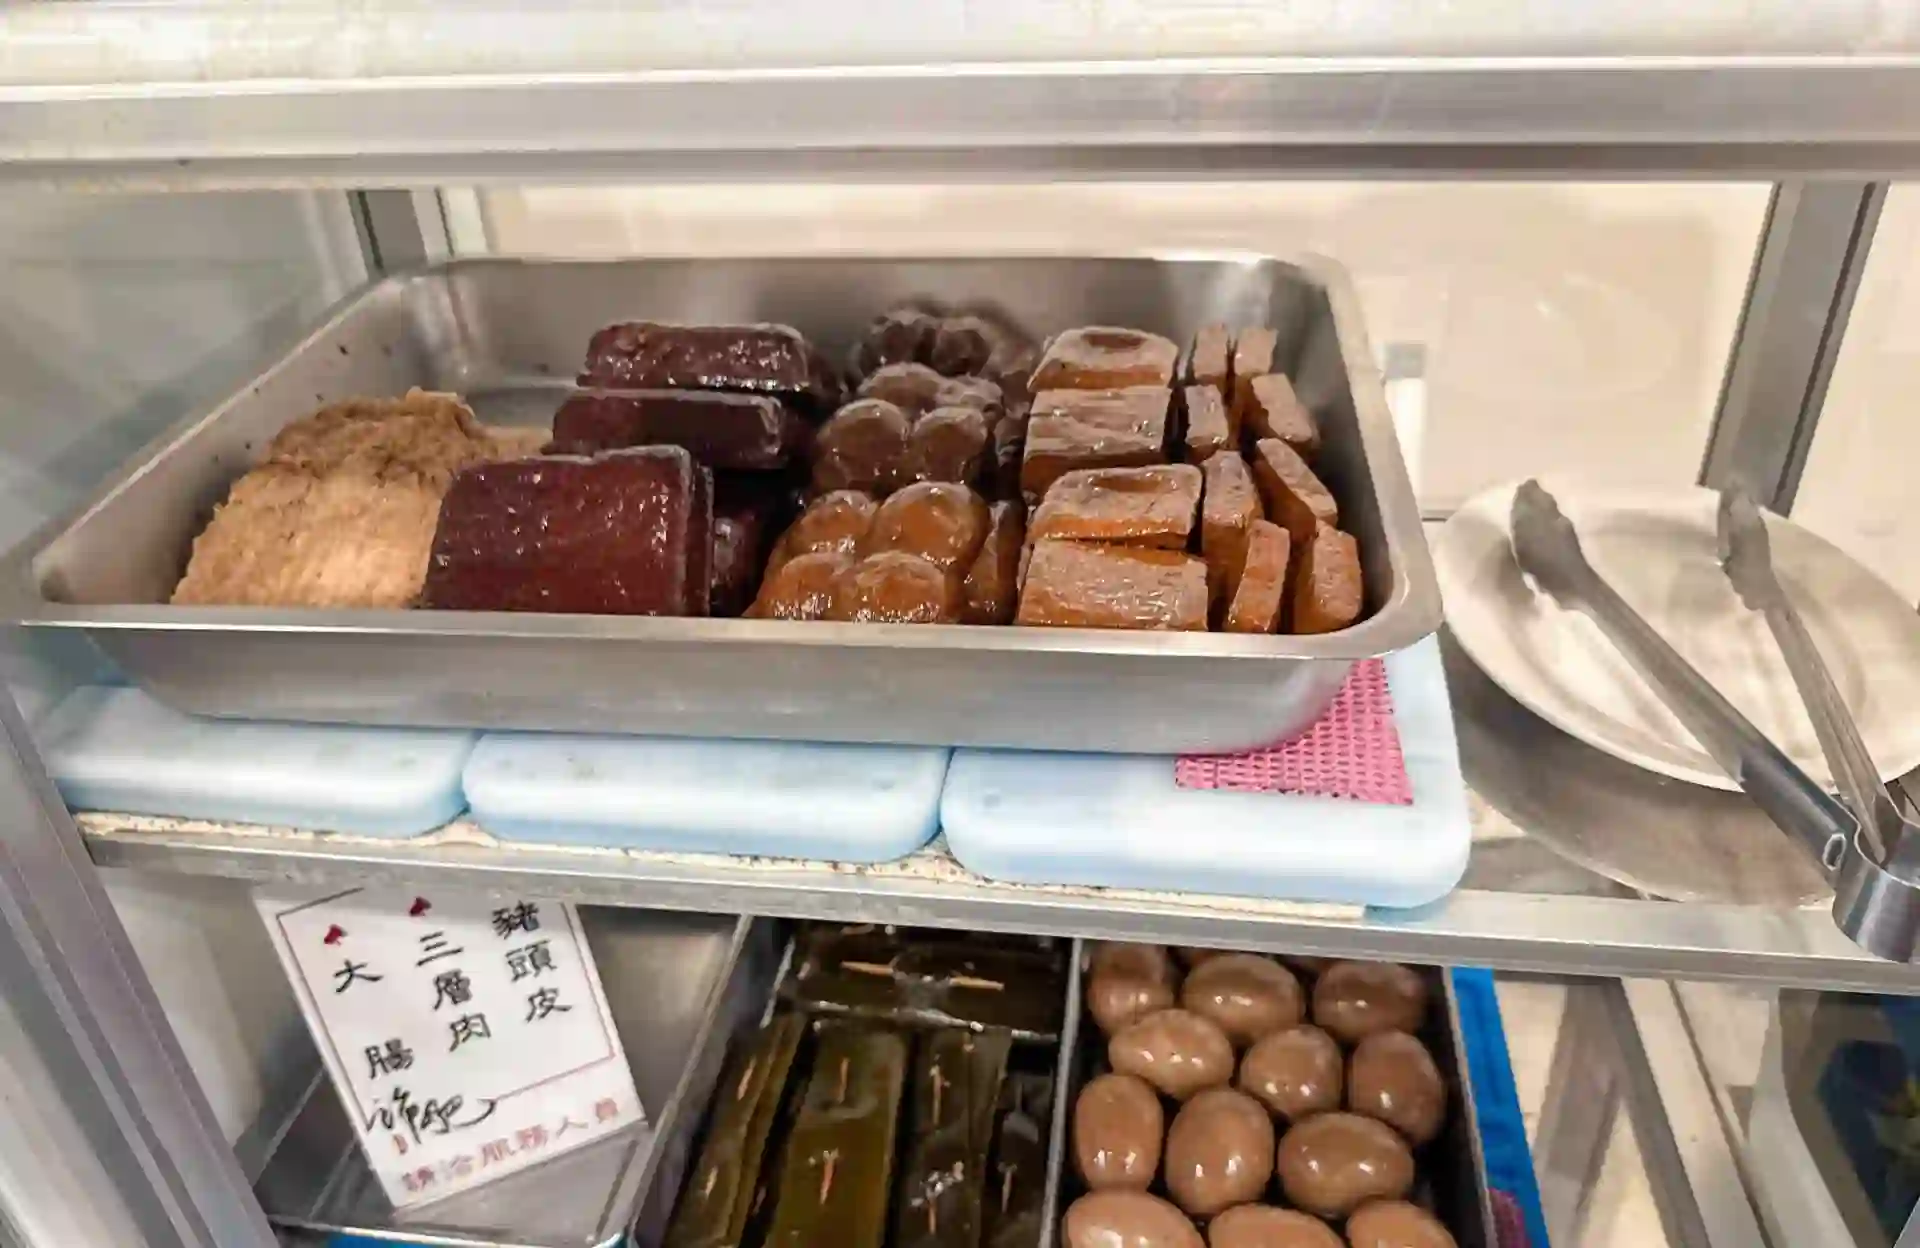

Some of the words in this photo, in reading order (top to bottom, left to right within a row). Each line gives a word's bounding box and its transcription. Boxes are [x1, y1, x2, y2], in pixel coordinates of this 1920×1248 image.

[333, 959, 414, 1079] 大腸
[416, 931, 491, 1052] 三層肉
[492, 901, 573, 1023] 豬頭皮
